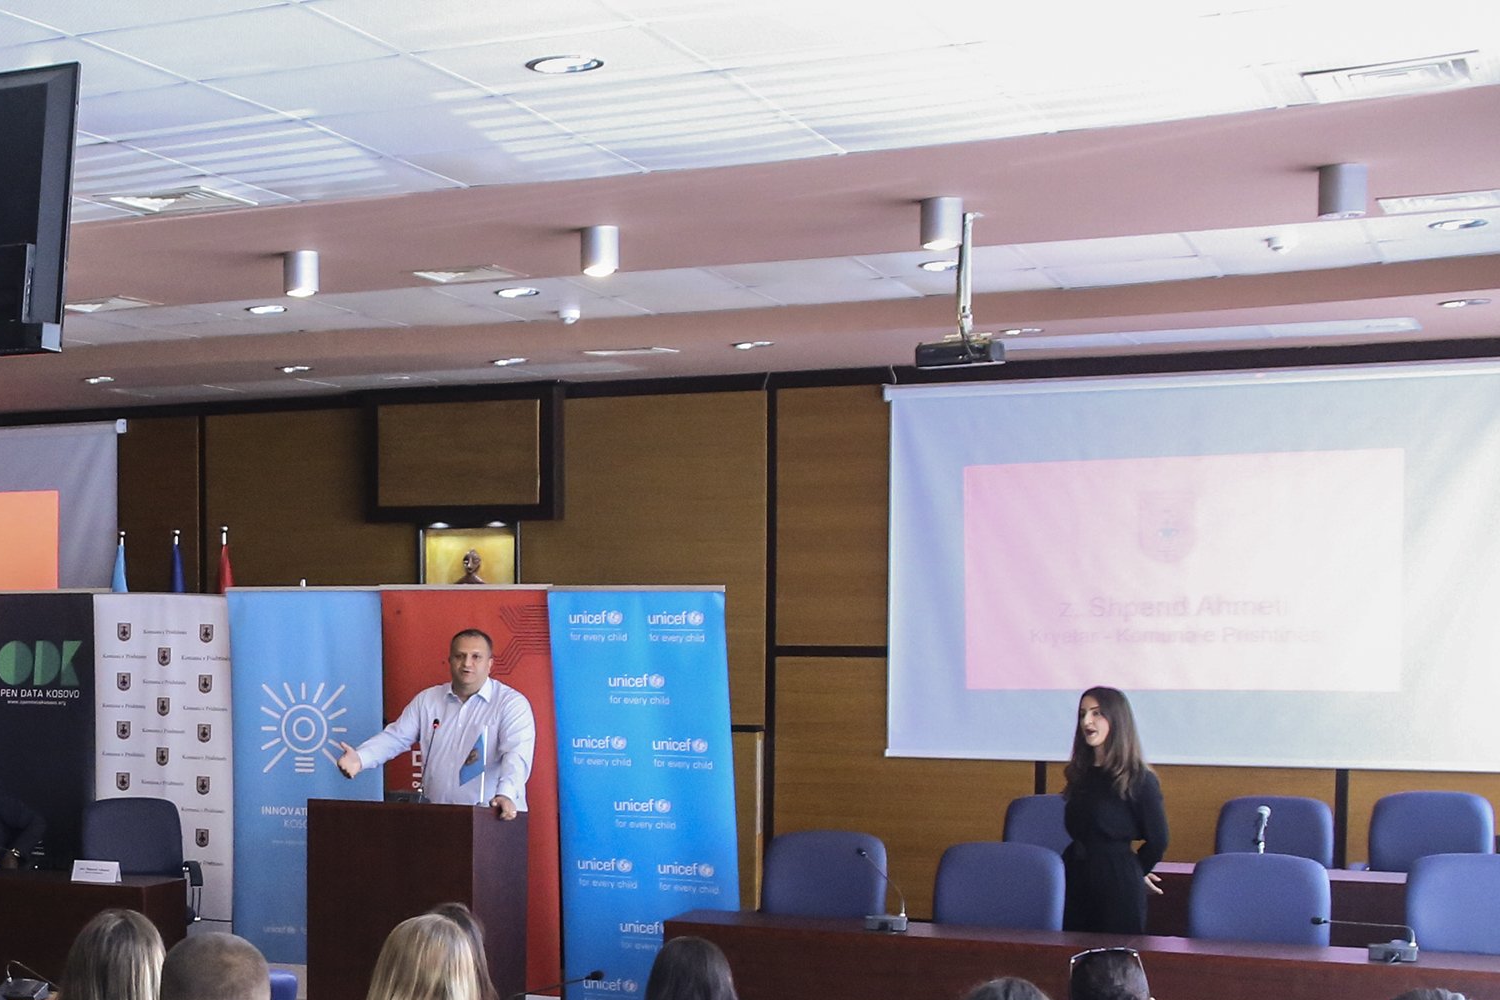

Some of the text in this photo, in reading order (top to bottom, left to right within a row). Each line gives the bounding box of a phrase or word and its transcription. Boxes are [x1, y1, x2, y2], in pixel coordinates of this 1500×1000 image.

[569, 610, 608, 625] unicef
[648, 611, 688, 625] unicef
[608, 673, 650, 688] unicef
[20, 689, 43, 698] DATA
[46, 689, 80, 699] KOSOVO
[572, 736, 611, 750] unicef
[652, 738, 692, 752] unicef
[614, 798, 655, 812] unicef
[578, 858, 616, 872] unicef
[658, 862, 698, 876] unicef
[620, 921, 660, 934] unicef
